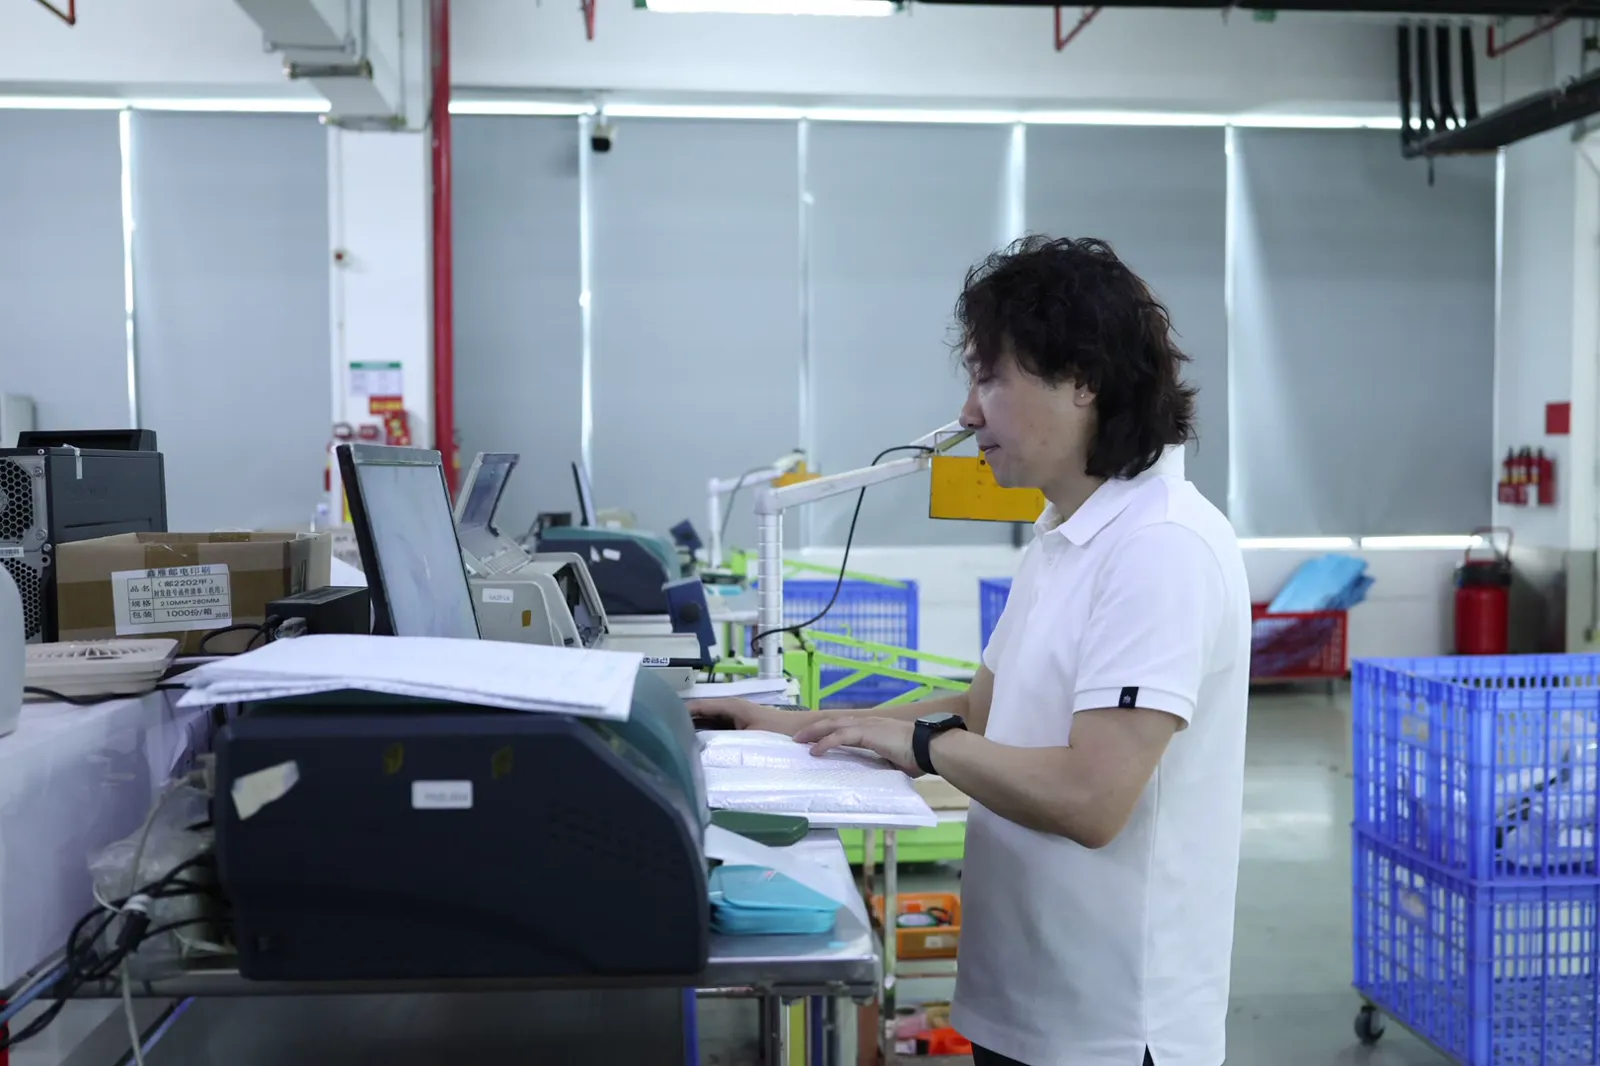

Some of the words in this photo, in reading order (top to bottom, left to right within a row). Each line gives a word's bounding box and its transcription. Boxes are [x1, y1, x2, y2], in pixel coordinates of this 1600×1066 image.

[131, 599, 151, 608] 规格
[132, 610, 152, 619] 包装
[167, 608, 212, 617] 1000份/箱
